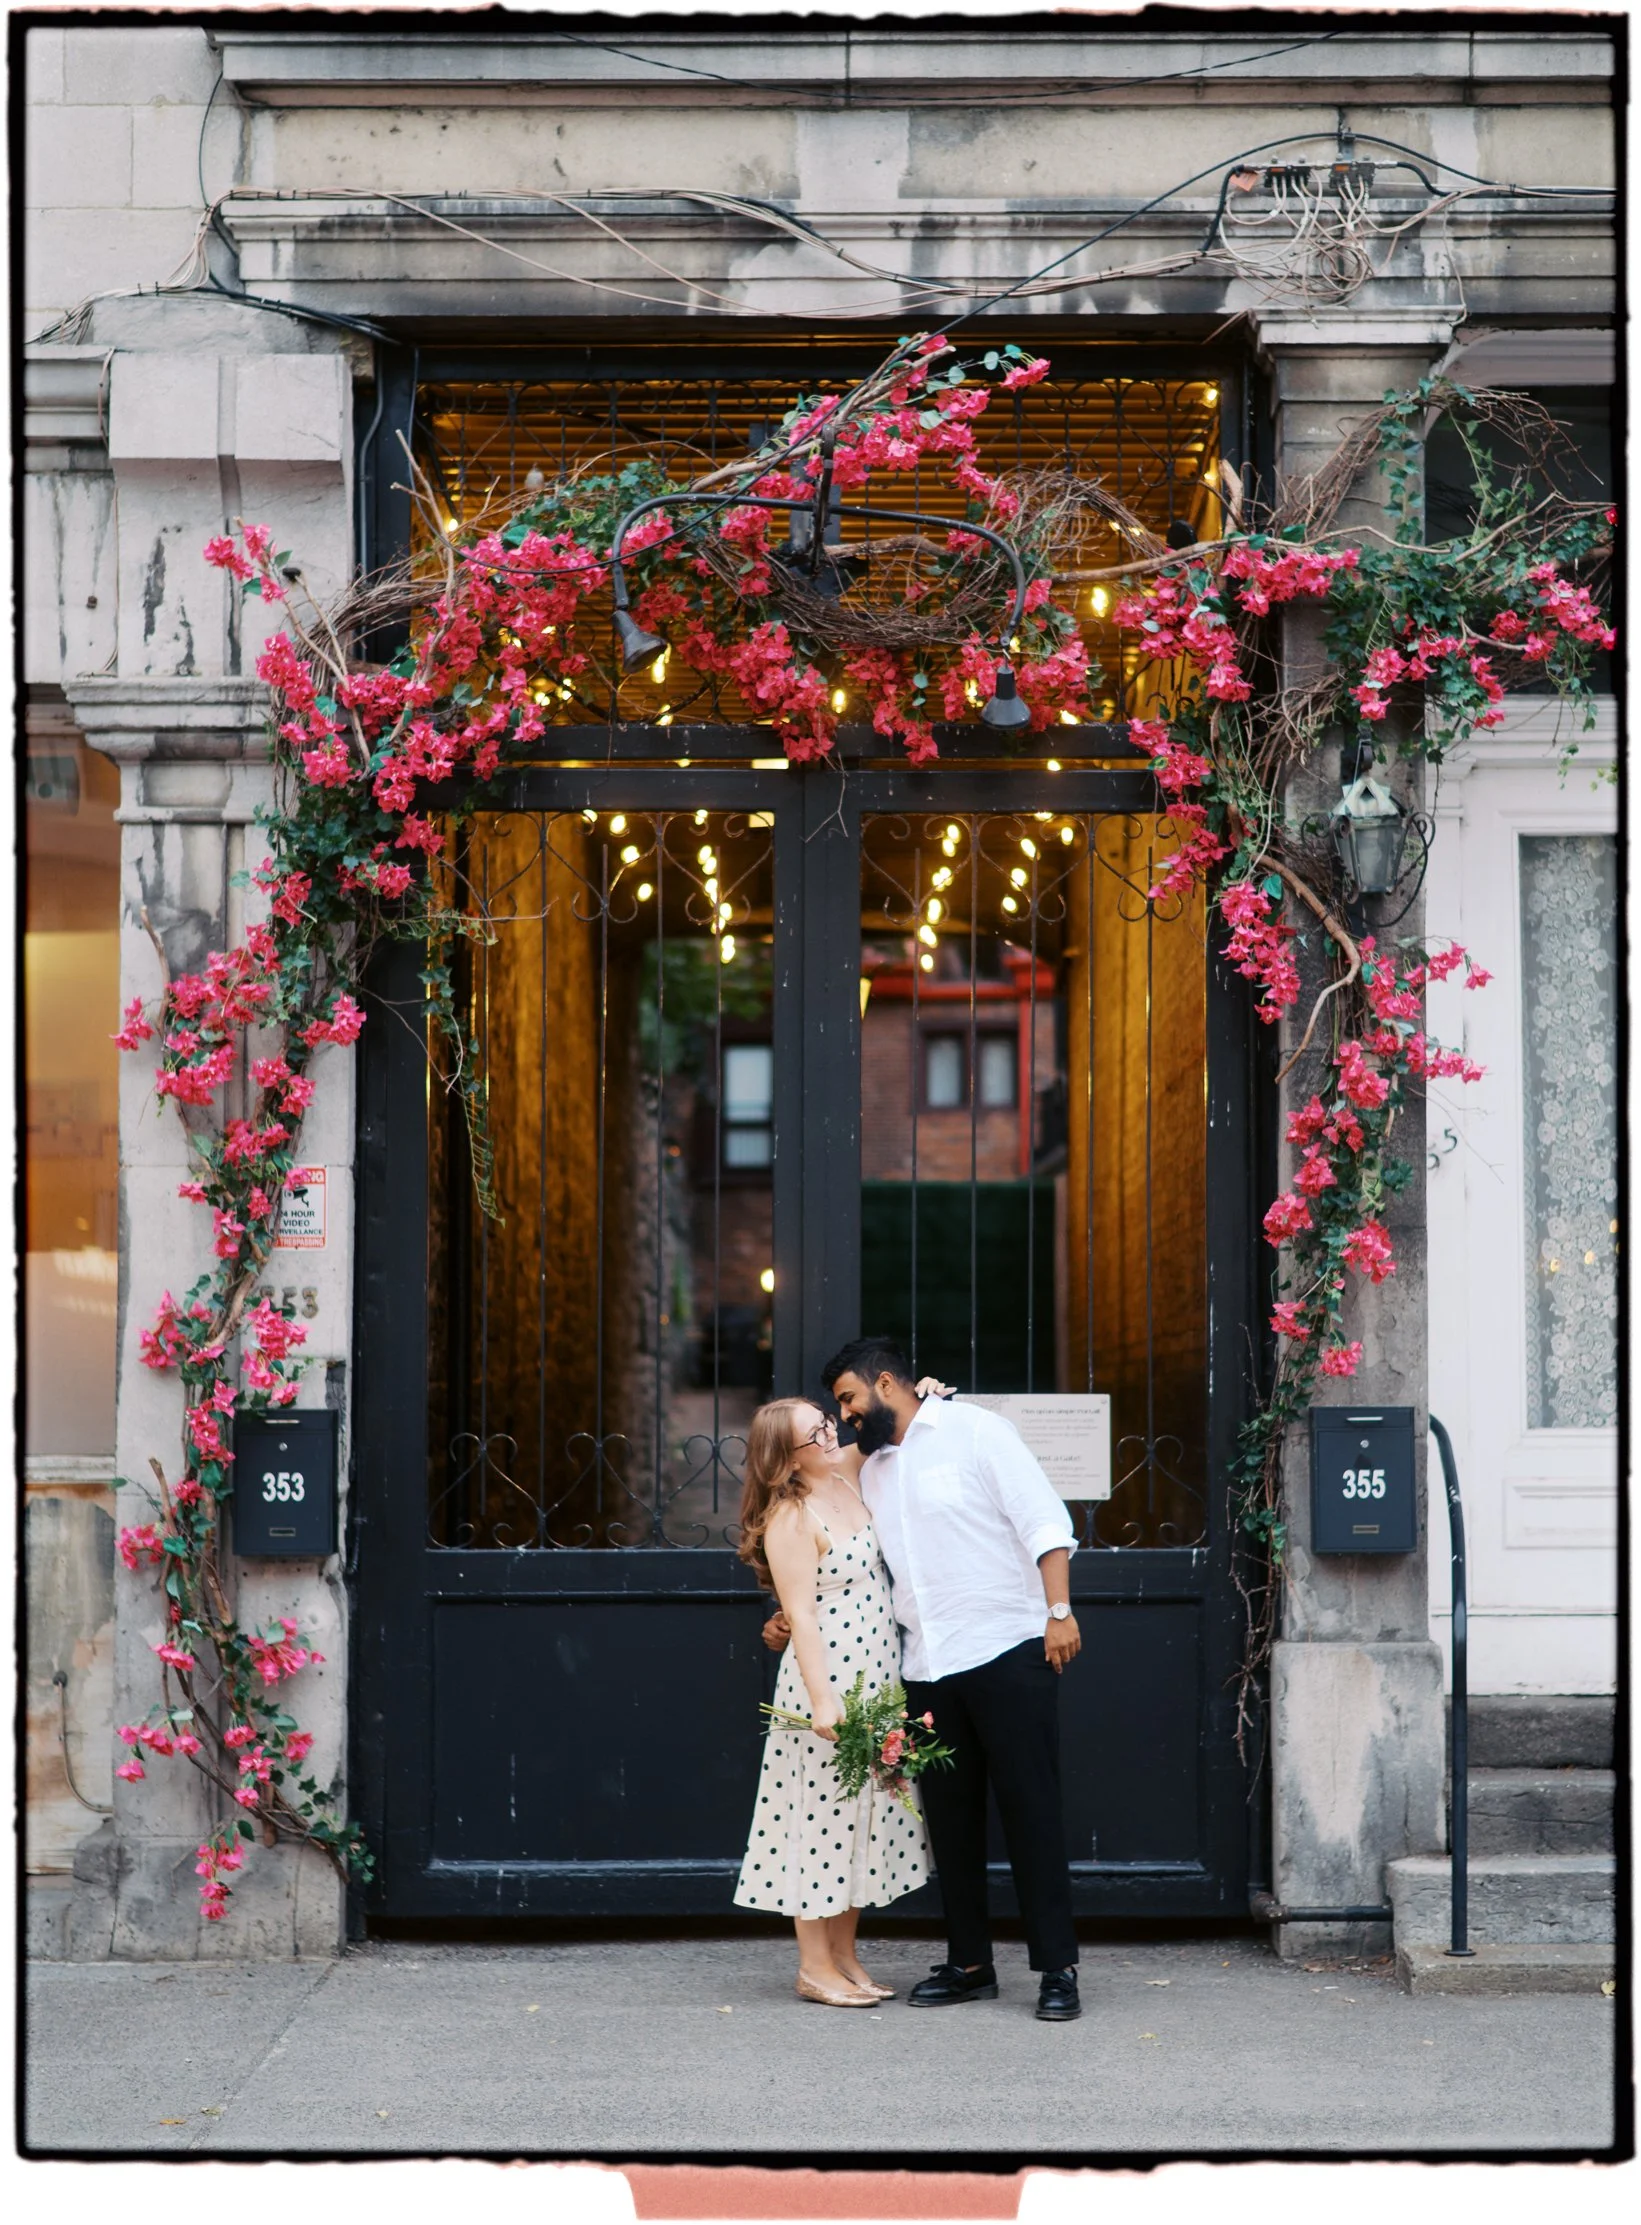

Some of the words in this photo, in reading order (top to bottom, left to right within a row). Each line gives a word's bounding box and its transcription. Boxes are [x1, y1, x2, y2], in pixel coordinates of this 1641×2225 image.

[283, 1219, 310, 1227] VIDEO
[262, 1472, 305, 1502] 353
[1342, 1469, 1386, 1499] 355
